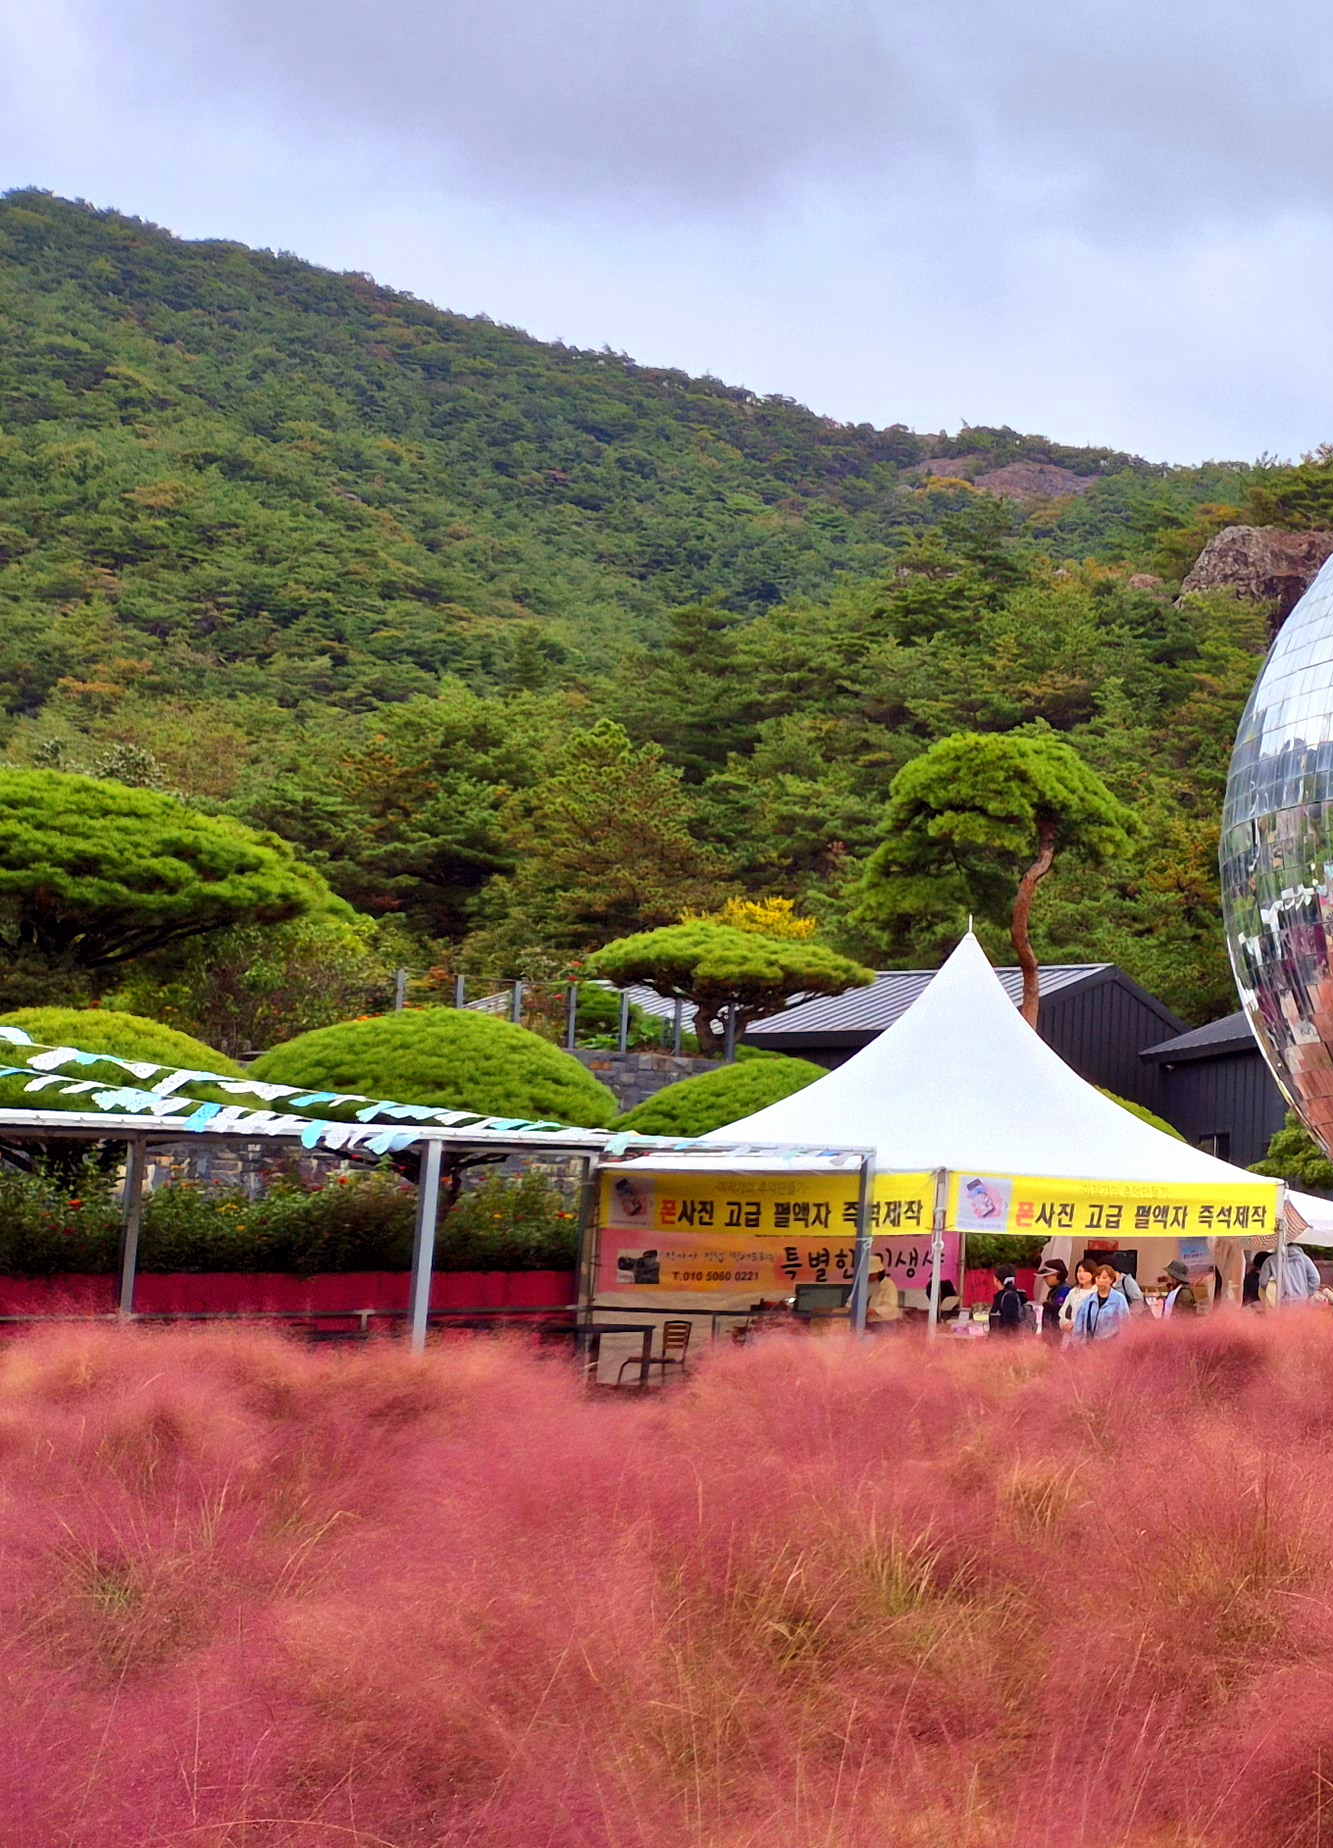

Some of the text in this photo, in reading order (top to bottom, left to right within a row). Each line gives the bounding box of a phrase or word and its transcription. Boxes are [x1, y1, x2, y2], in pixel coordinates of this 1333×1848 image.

[660, 1199, 714, 1227] 폰사진
[724, 1201, 762, 1227] 고급
[1015, 1201, 1075, 1228] 폰사진
[1084, 1204, 1123, 1229] 고급
[1197, 1205, 1267, 1229] 즉석제작
[672, 1271, 759, 1282] T.010 5060 0221
[781, 1246, 855, 1283] 특별한
